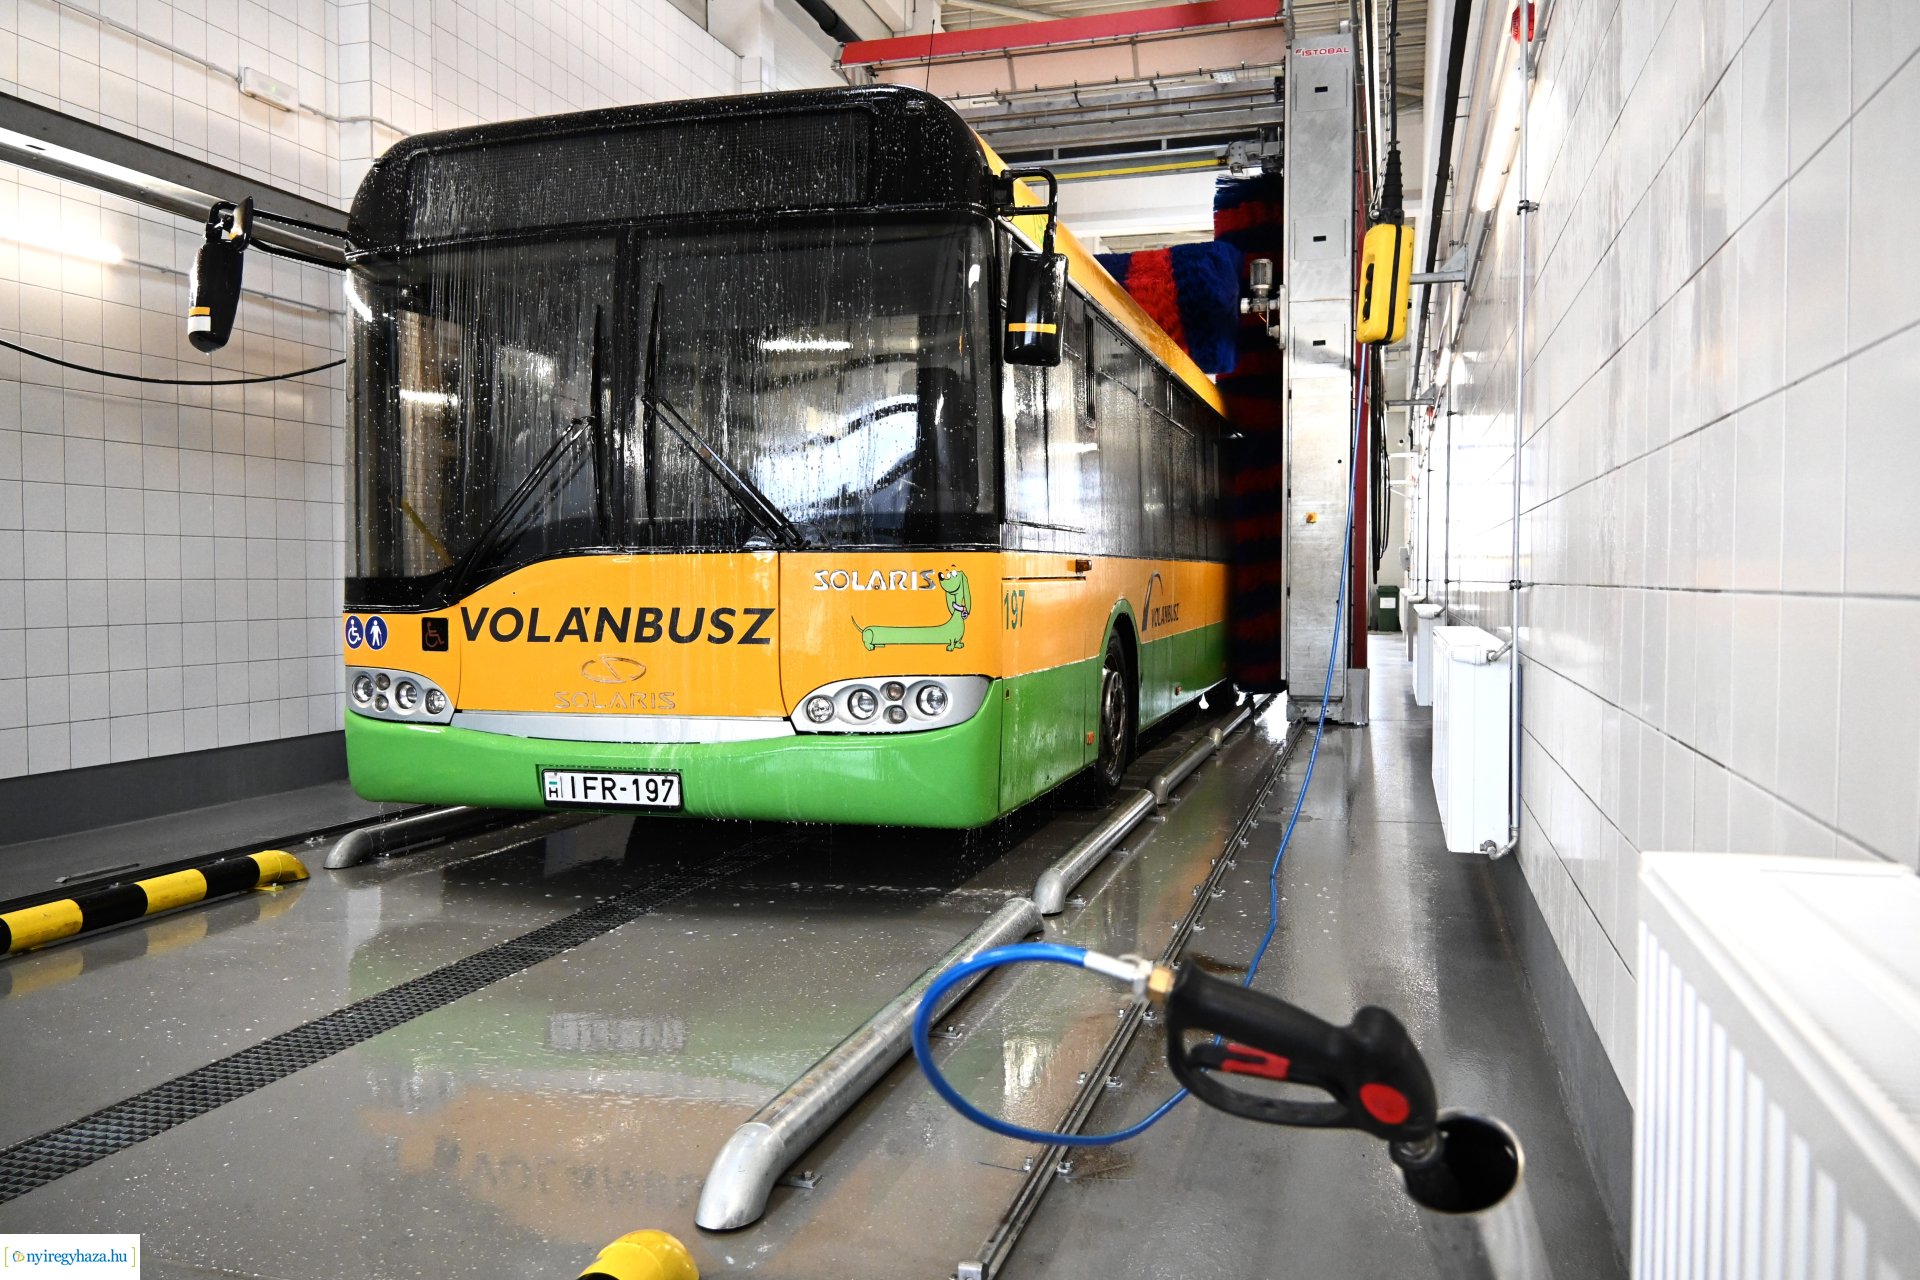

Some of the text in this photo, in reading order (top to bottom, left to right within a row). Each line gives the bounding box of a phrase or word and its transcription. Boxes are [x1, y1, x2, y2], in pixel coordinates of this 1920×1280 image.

[813, 569, 937, 591] SOLARIS
[1003, 589, 1026, 630] 197
[460, 606, 776, 645] VOLÁNBUSZ
[554, 691, 676, 710] SOLARIS
[548, 775, 675, 803] H IFR-197
